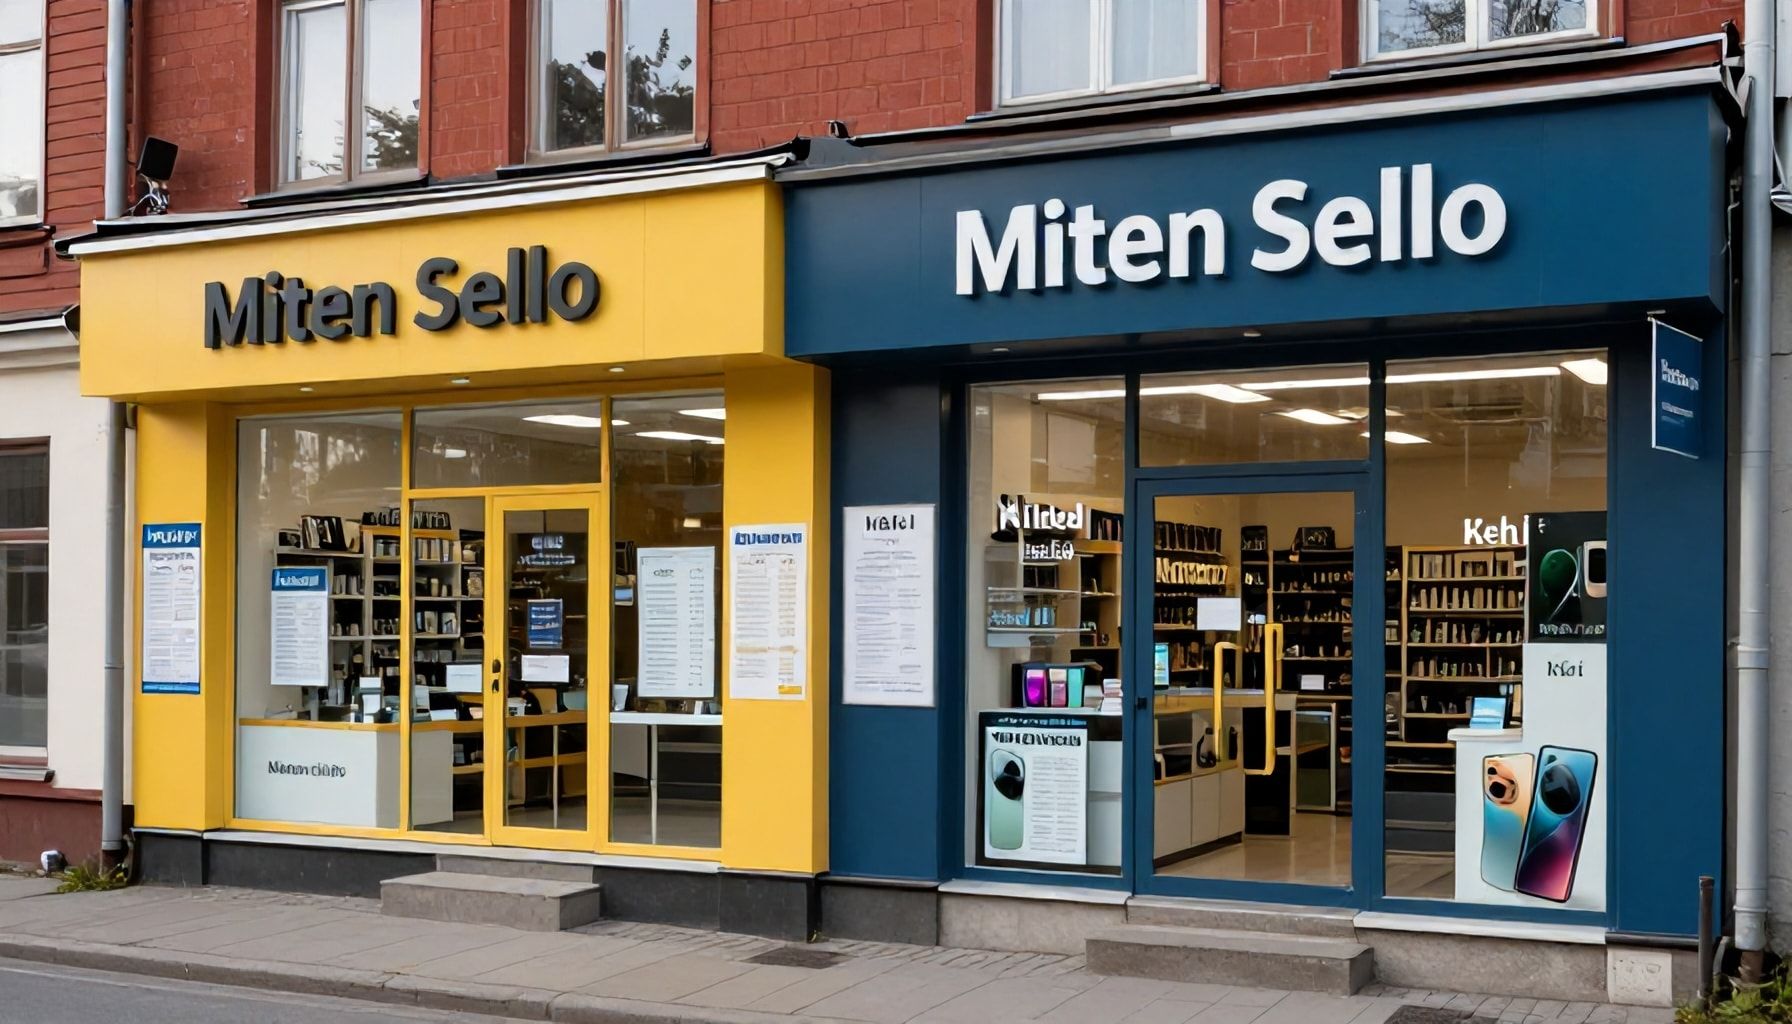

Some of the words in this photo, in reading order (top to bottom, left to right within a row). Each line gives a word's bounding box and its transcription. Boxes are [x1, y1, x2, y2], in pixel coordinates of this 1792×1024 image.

[956, 198, 1225, 295] Miten
[1251, 163, 1507, 273] Sello
[204, 271, 396, 350] Miten
[414, 245, 600, 331] Sello
